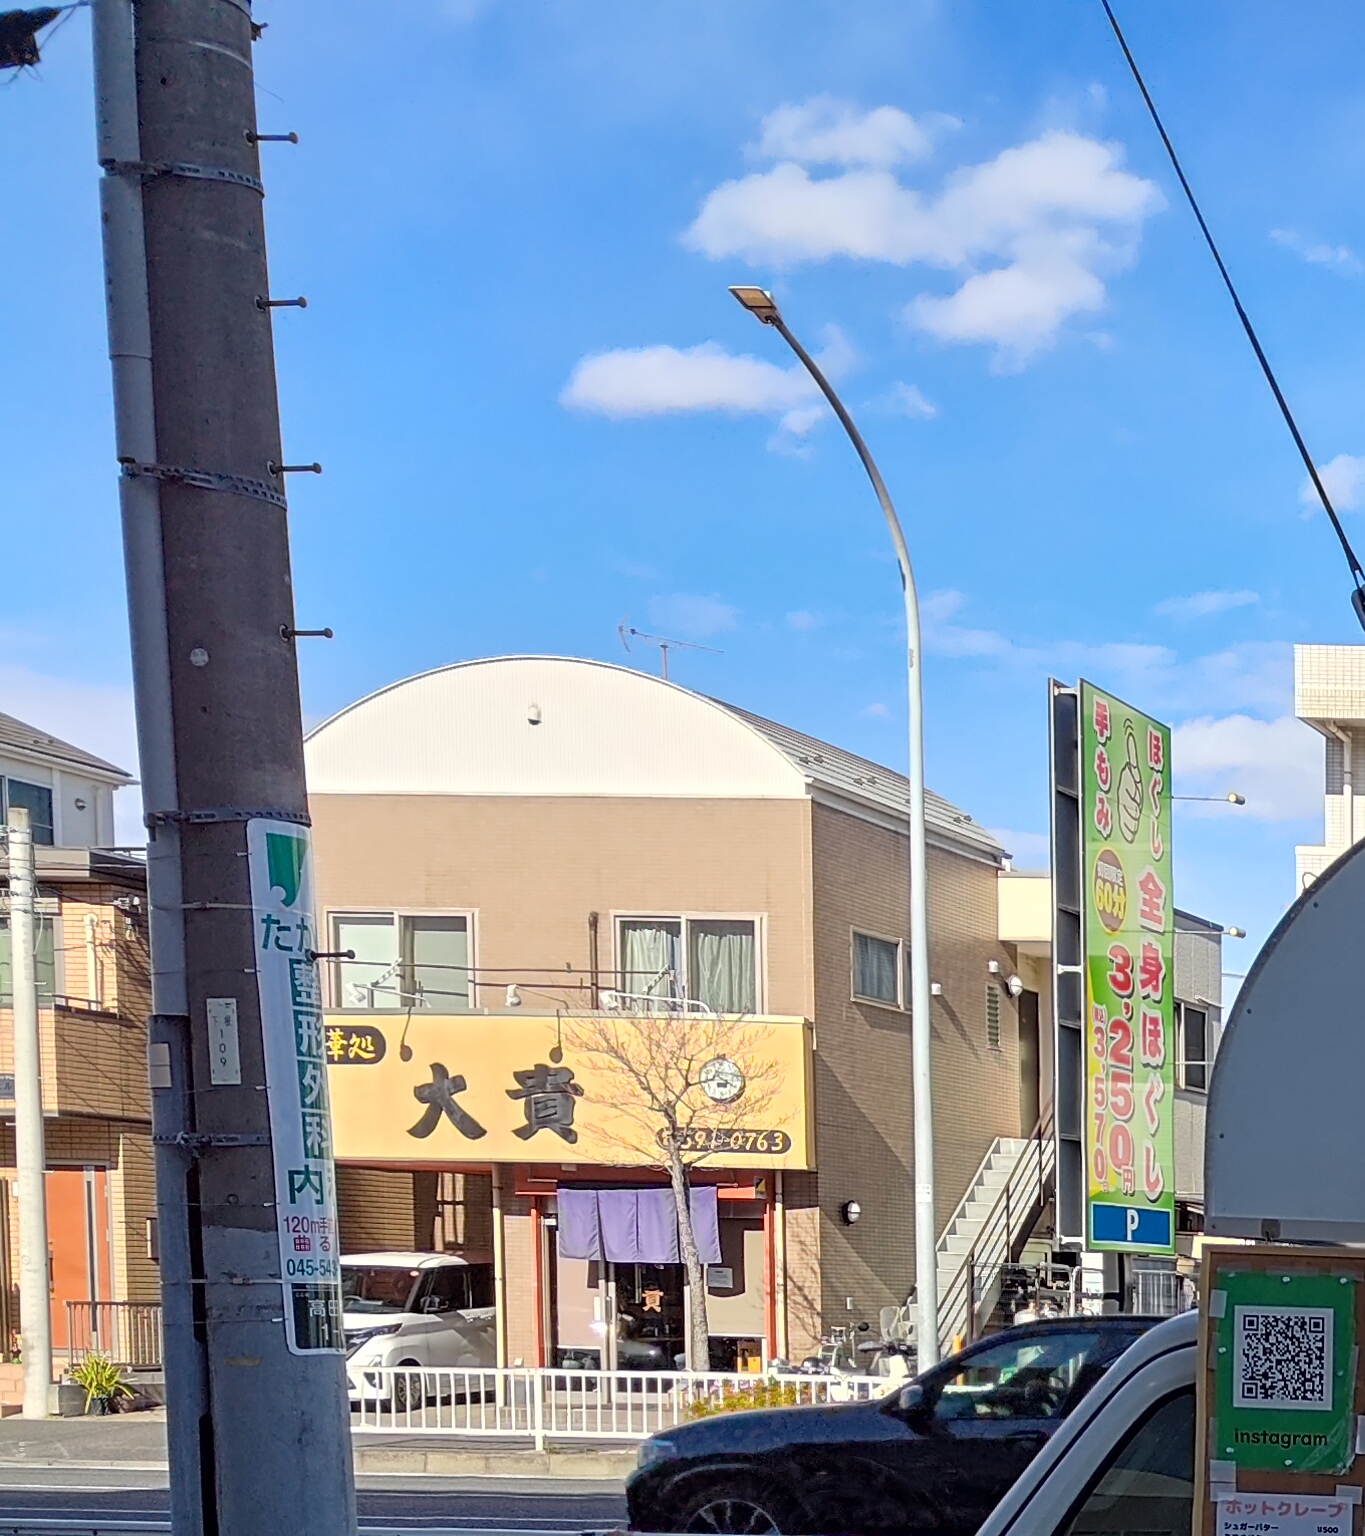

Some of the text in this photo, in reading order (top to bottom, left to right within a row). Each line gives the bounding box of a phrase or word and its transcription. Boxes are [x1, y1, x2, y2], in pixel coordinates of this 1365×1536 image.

[1096, 879, 1126, 920] 60分
[1137, 865, 1165, 1202] 全身ほぐし
[407, 1062, 584, 1144] 大貴
[1127, 1209, 1139, 1241] P
[1233, 1428, 1328, 1450] instagram
[1226, 1500, 1348, 1517] ホットクレープ
[1224, 1522, 1278, 1531] シュガーバター
